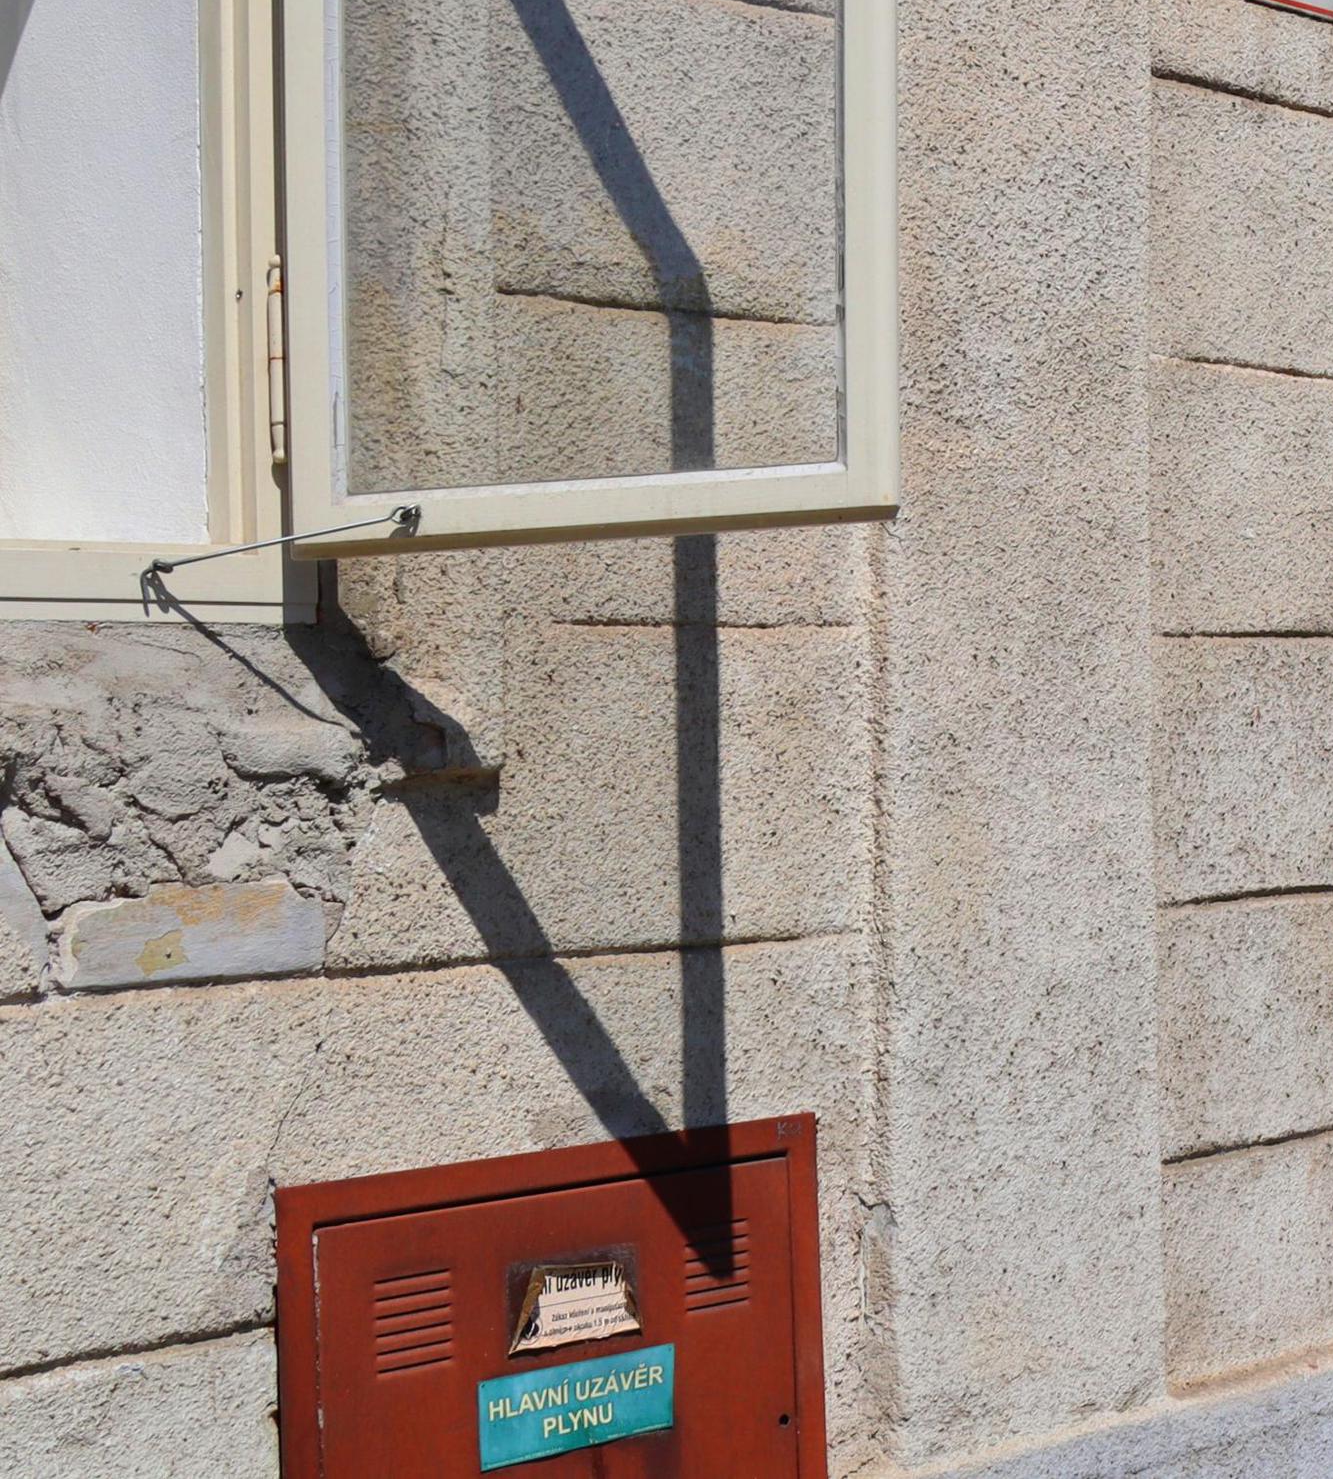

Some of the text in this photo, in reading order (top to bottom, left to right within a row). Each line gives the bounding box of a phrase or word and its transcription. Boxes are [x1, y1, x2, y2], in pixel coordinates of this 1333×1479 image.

[489, 1363, 664, 1421] HLAVNÍ UZÁVĚR
[543, 1403, 613, 1439] PLYNU
